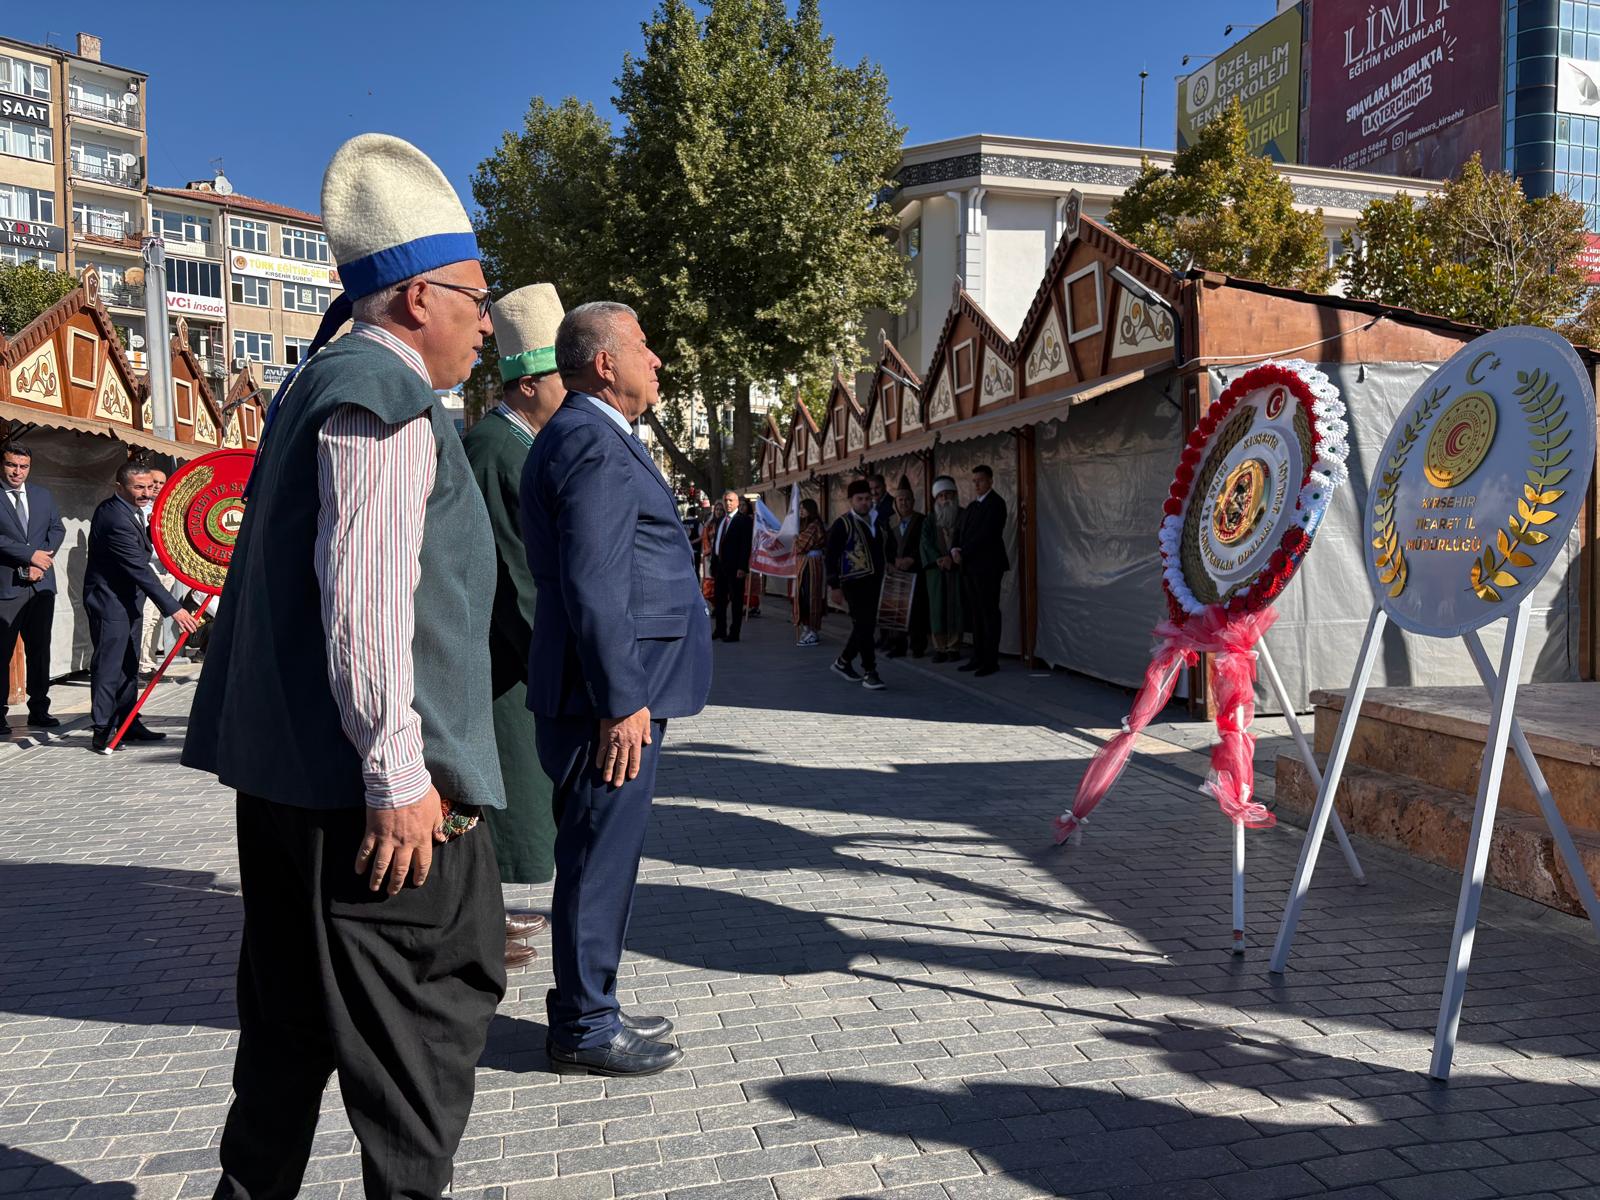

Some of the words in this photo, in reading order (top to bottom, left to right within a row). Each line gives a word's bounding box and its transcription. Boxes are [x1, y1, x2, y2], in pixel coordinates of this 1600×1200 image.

[1349, 52, 1381, 80] EĞİTİM
[1383, 16, 1445, 60] KURUMLARI
[1217, 71, 1245, 98] OSB
[1248, 42, 1289, 79] BİLİM
[1218, 50, 1251, 82] ÖZEL
[1240, 57, 1289, 102] KOLEJİ
[1346, 83, 1390, 123] SINAVLARA
[1391, 46, 1443, 92] HAZIRLIKTA
[0, 99, 47, 121] ŞAAT
[1240, 85, 1280, 127] EVLET
[1348, 151, 1359, 163] 501
[1360, 147, 1367, 157] 10
[1359, 156, 1367, 166] 10
[8, 232, 50, 248] İNŞAAT
[249, 258, 274, 271] TÜRK
[193, 302, 224, 313] inşaat
[210, 484, 226, 497] VE
[1422, 493, 1476, 510] KIRŞEHİR
[1465, 514, 1476, 530] İL
[1405, 535, 1482, 552] MÜDÜRLÜĞÜ
